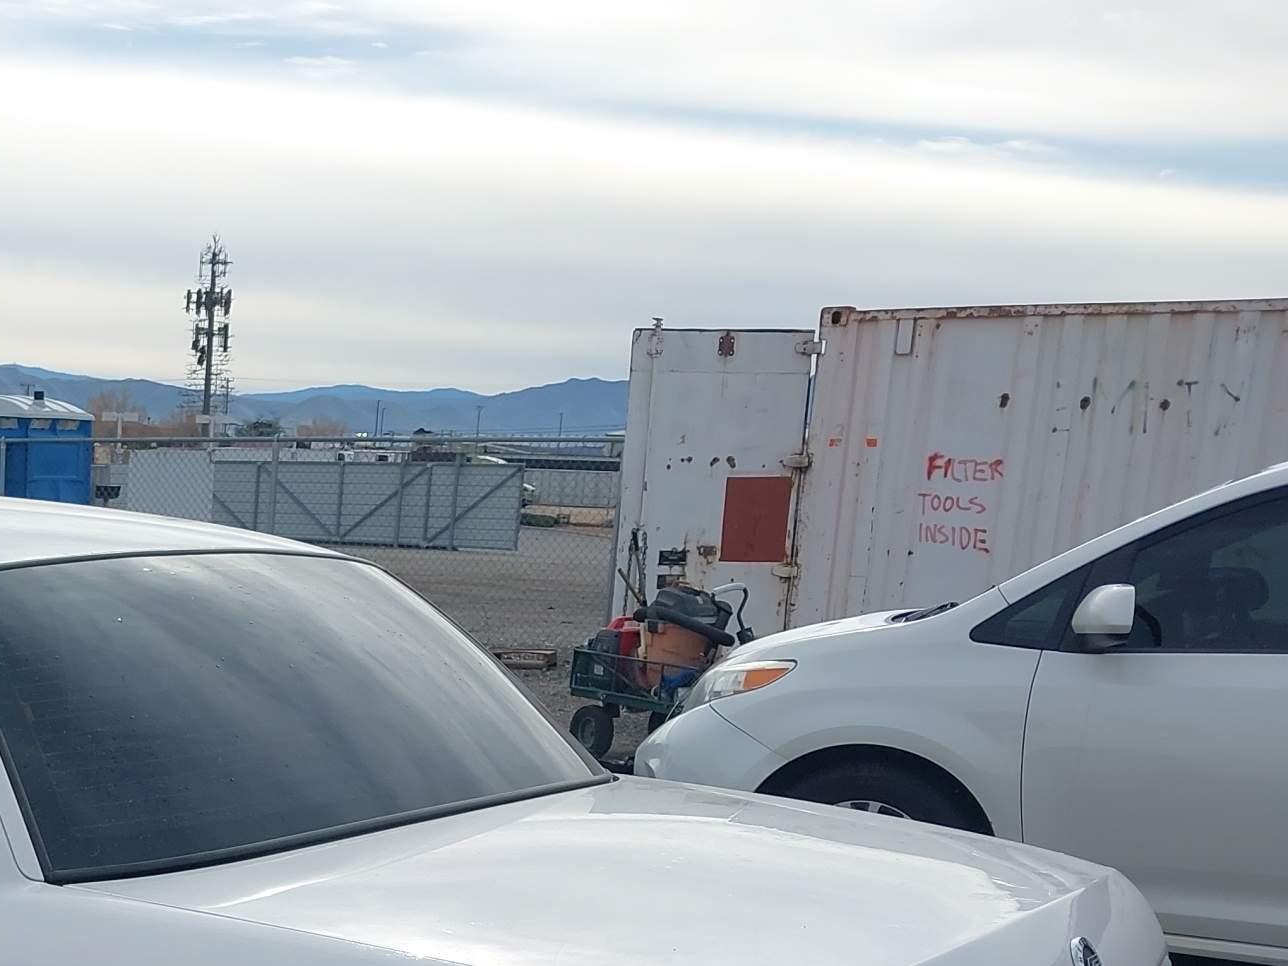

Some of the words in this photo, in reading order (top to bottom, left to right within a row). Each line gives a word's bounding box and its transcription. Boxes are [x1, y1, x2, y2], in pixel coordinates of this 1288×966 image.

[926, 452, 1004, 482] FILTER
[918, 493, 987, 516] TOOLS
[919, 523, 990, 553] INSIDE
